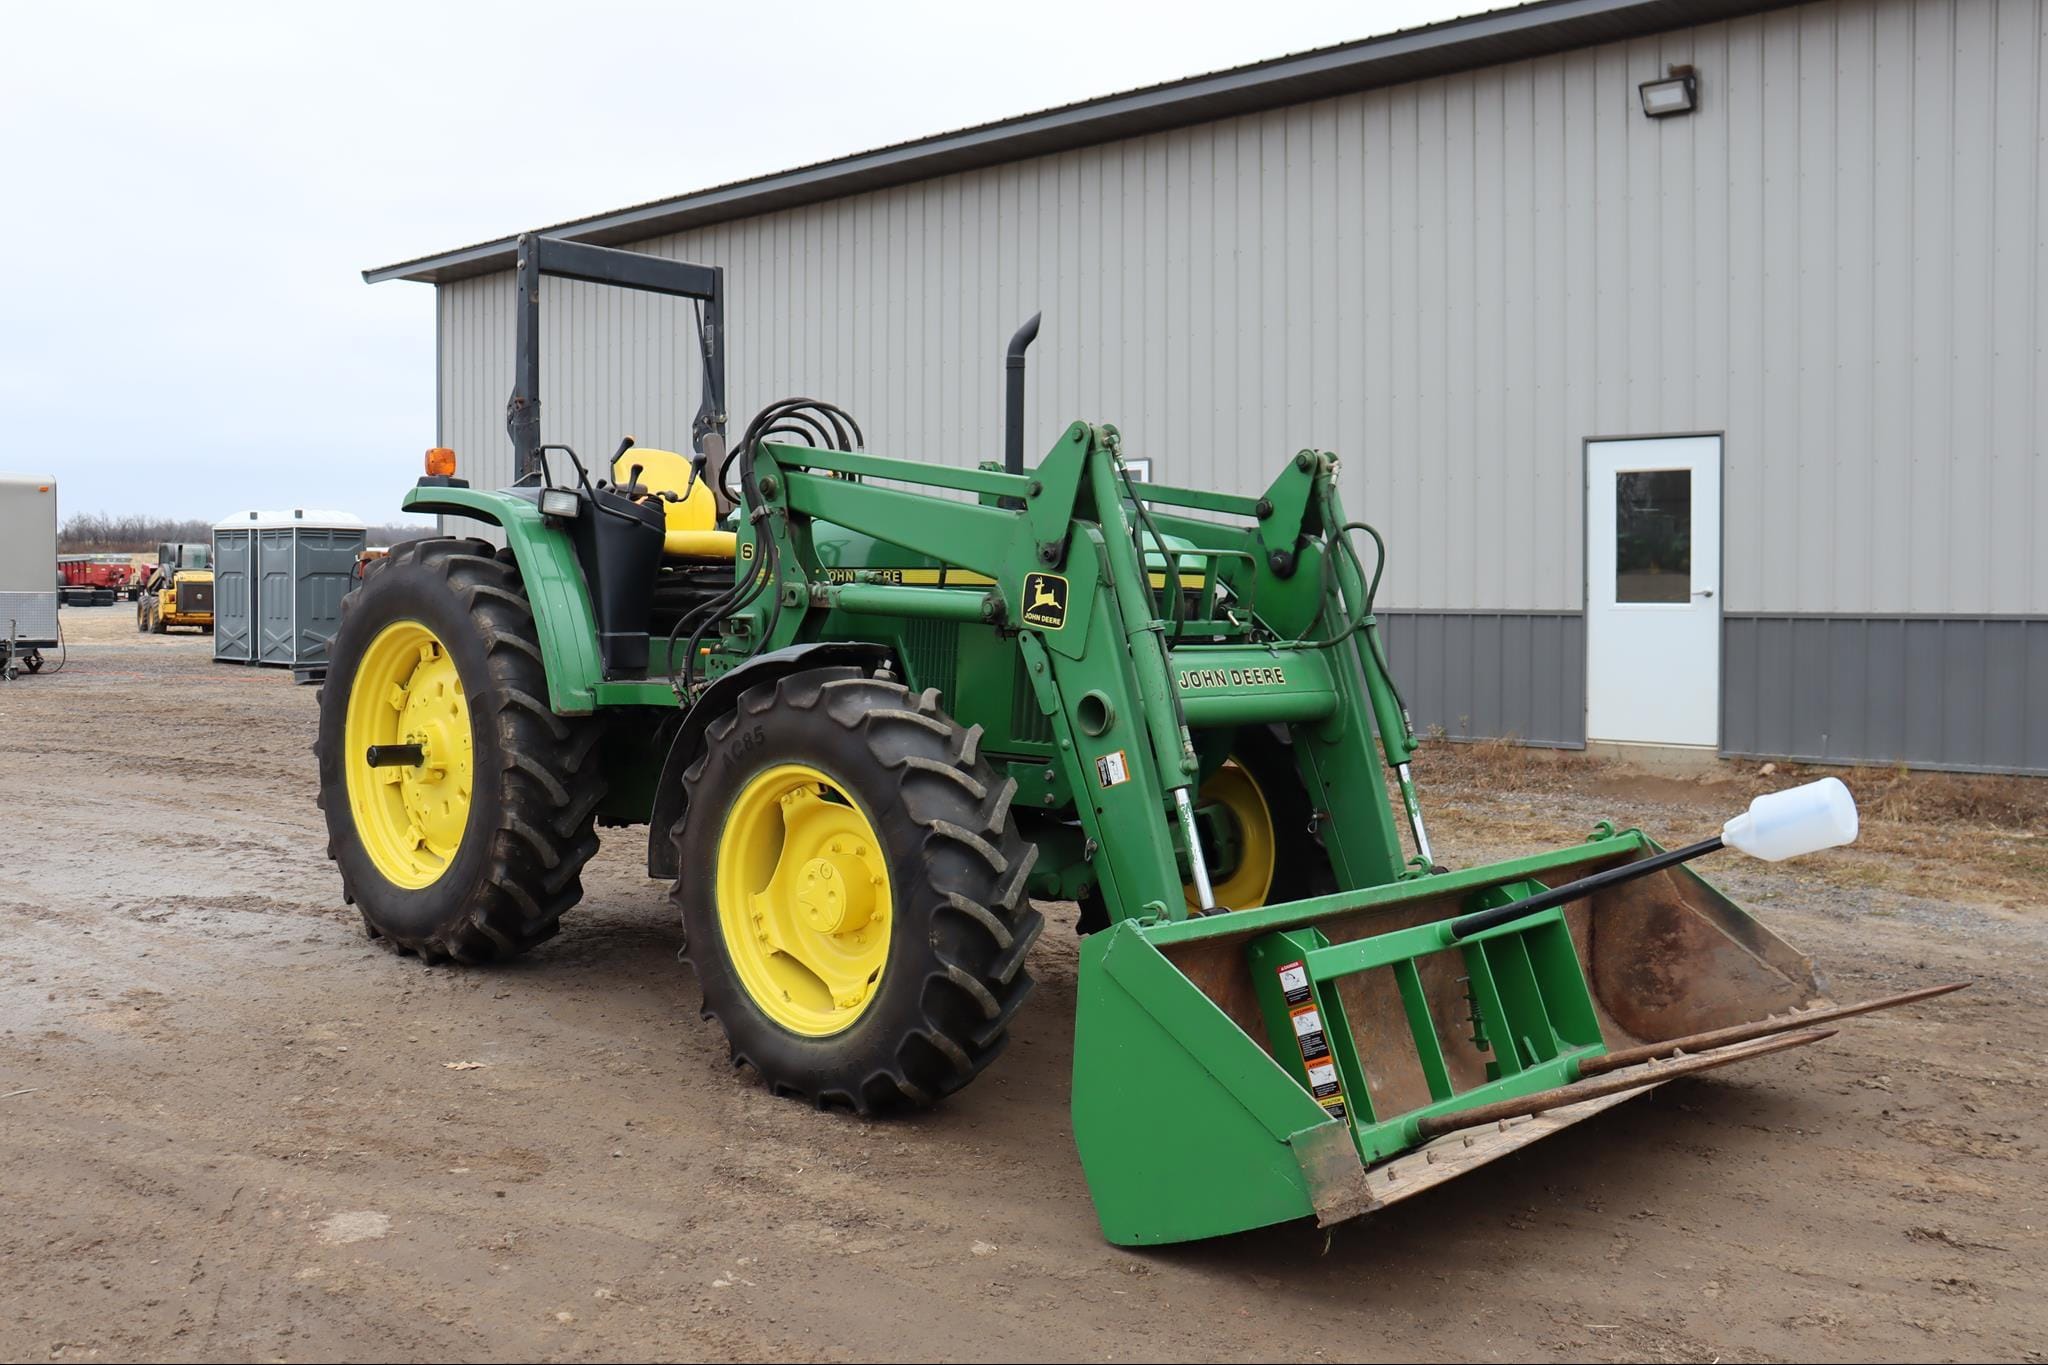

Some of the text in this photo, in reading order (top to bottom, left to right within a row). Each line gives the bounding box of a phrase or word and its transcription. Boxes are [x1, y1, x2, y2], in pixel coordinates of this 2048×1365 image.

[828, 570, 855, 582] OHN
[1025, 612, 1061, 625] JOHN DEERE
[1180, 667, 1286, 689] JOHN DEERE
